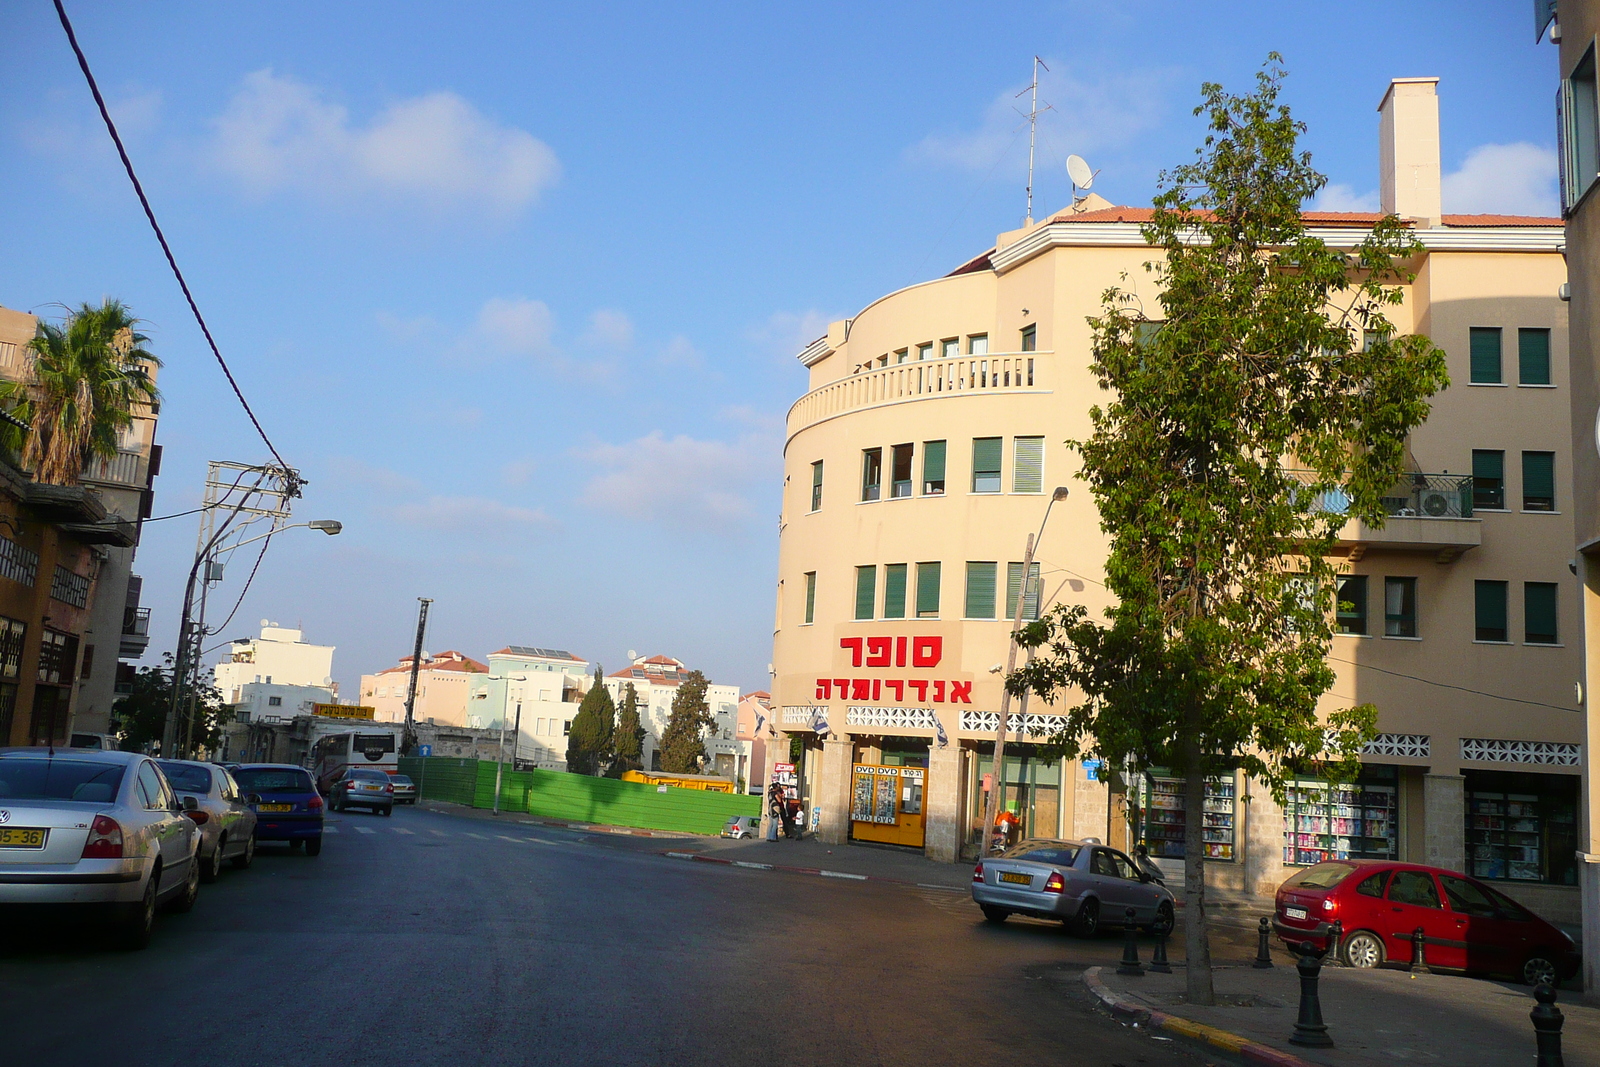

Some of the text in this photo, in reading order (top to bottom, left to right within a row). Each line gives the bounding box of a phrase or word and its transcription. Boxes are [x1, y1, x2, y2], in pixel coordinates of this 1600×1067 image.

[840, 636, 943, 668] סופר
[815, 678, 973, 704] אנדרומדה
[855, 766, 875, 774] DVD
[877, 767, 898, 775] DVD
[854, 813, 870, 821] DVD
[876, 816, 893, 824] DVD
